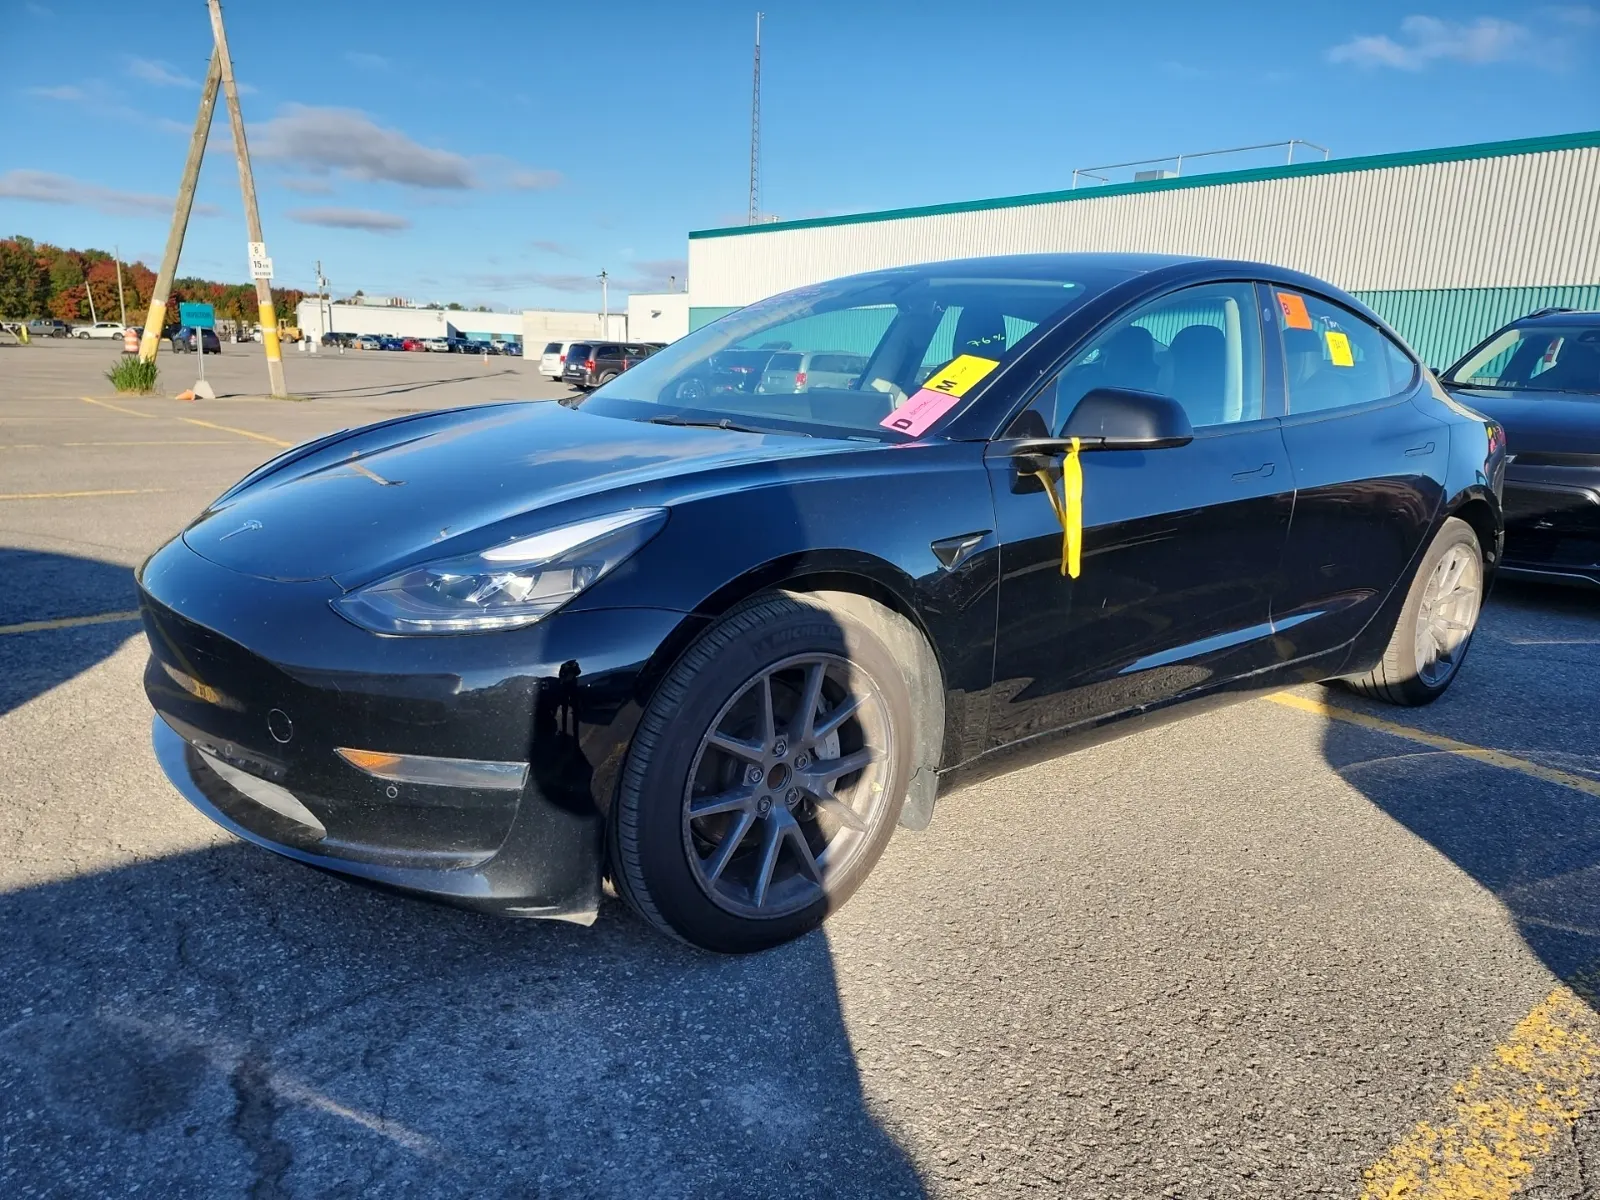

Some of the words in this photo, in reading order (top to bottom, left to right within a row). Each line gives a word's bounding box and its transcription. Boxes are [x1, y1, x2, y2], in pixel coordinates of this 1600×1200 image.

[253, 260, 262, 269] 15
[935, 379, 958, 392] M
[891, 418, 913, 431] D
